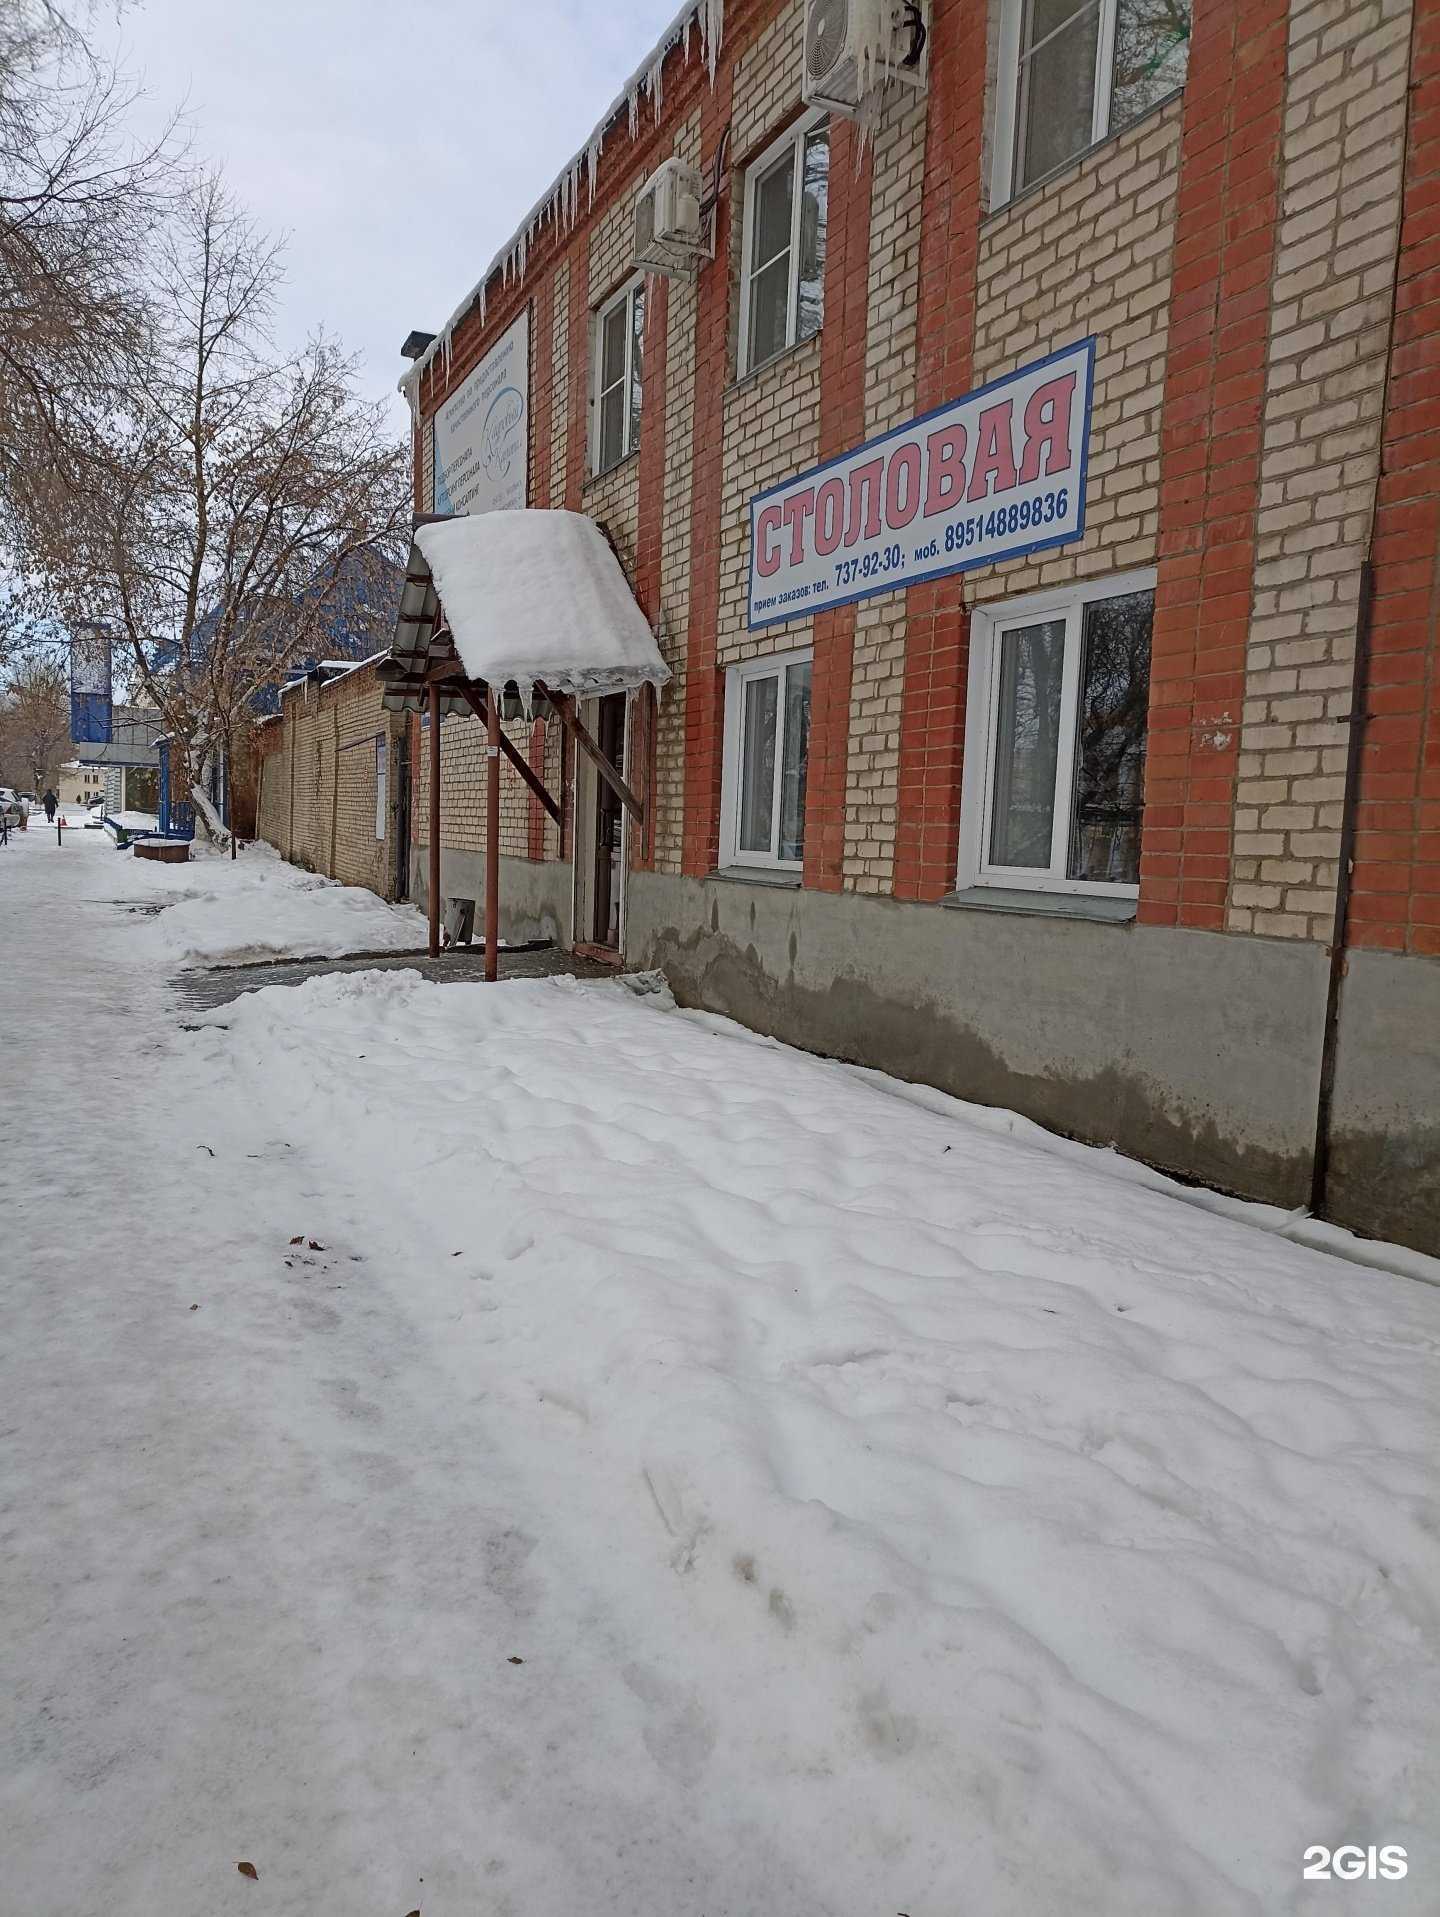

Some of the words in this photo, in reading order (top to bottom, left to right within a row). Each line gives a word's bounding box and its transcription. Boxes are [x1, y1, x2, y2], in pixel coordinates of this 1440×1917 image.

[754, 599, 777, 613] прием
[778, 585, 811, 605] заказов:
[812, 580, 829, 594] тел.
[835, 543, 905, 586] 737-92-30;
[914, 538, 940, 561] моб.
[944, 488, 1068, 552] 89514889836
[757, 371, 1077, 577] СТОЛОВАЯ
